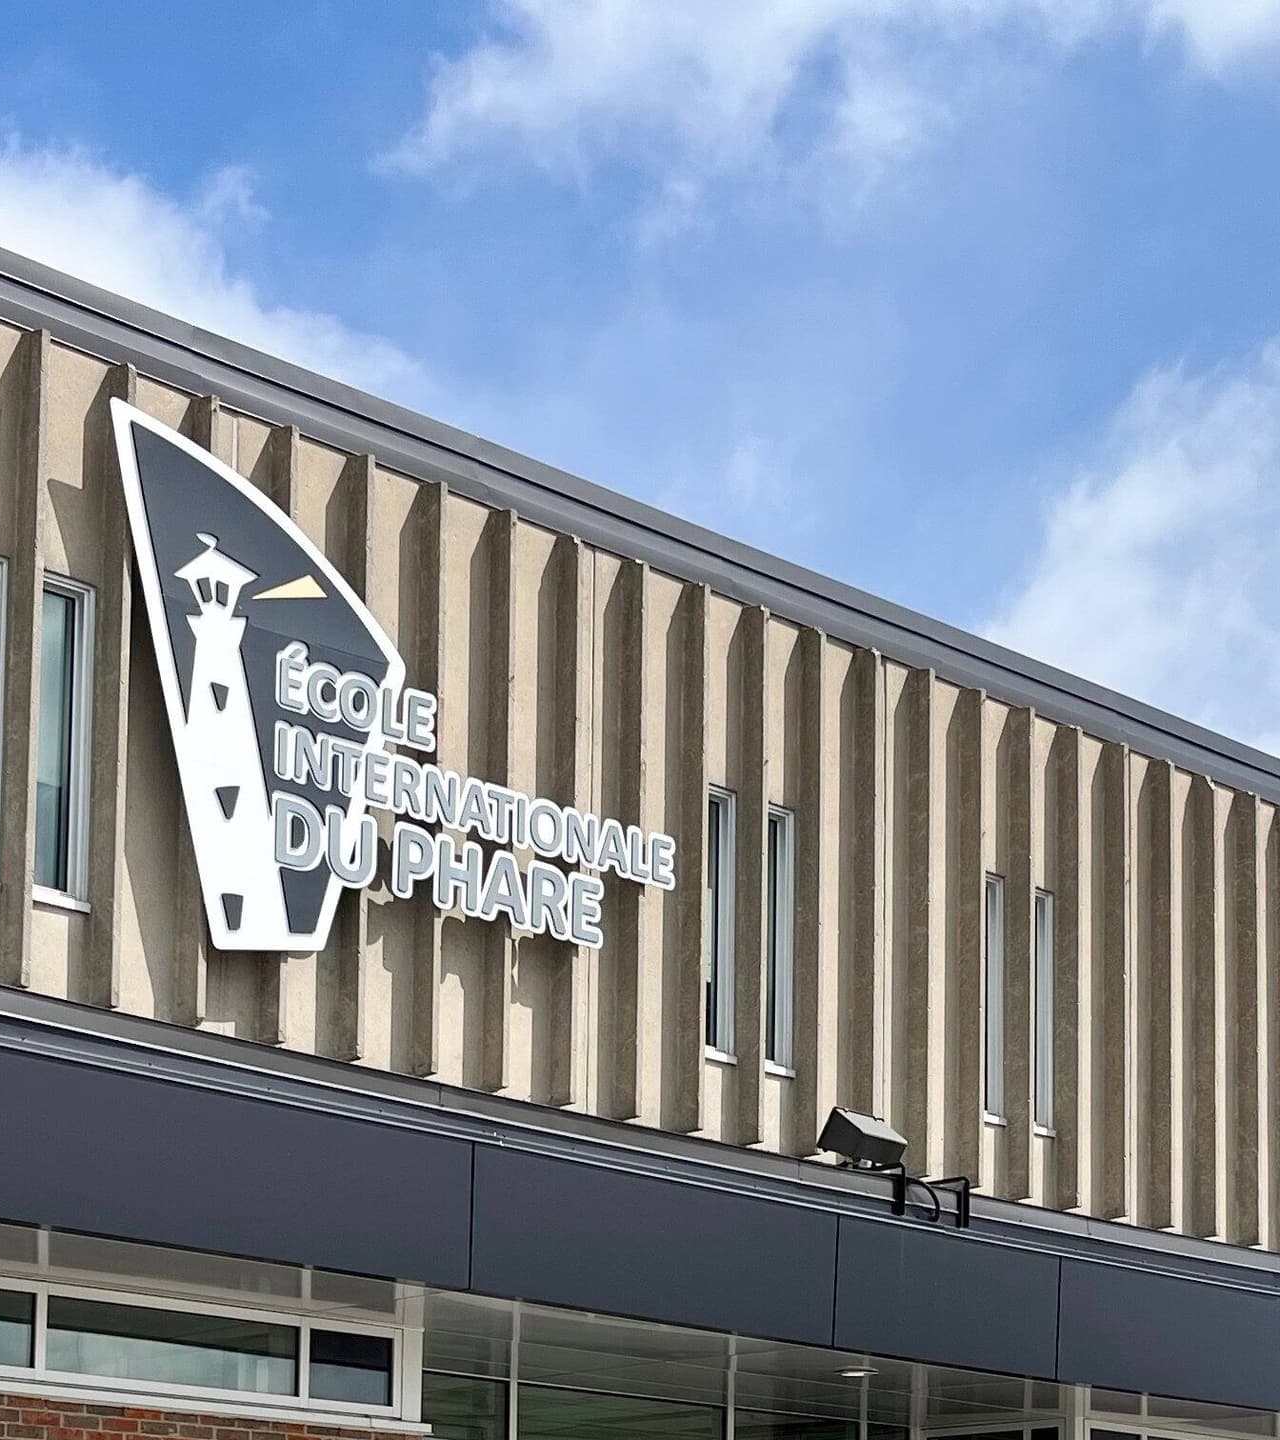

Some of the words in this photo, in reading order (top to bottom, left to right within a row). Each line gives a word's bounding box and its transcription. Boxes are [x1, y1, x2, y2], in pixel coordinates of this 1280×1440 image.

[277, 646, 434, 748] ÉCOLE
[273, 796, 375, 884] DU
[395, 828, 602, 945] PHARE
[275, 725, 674, 886] INTERNATIONALE
